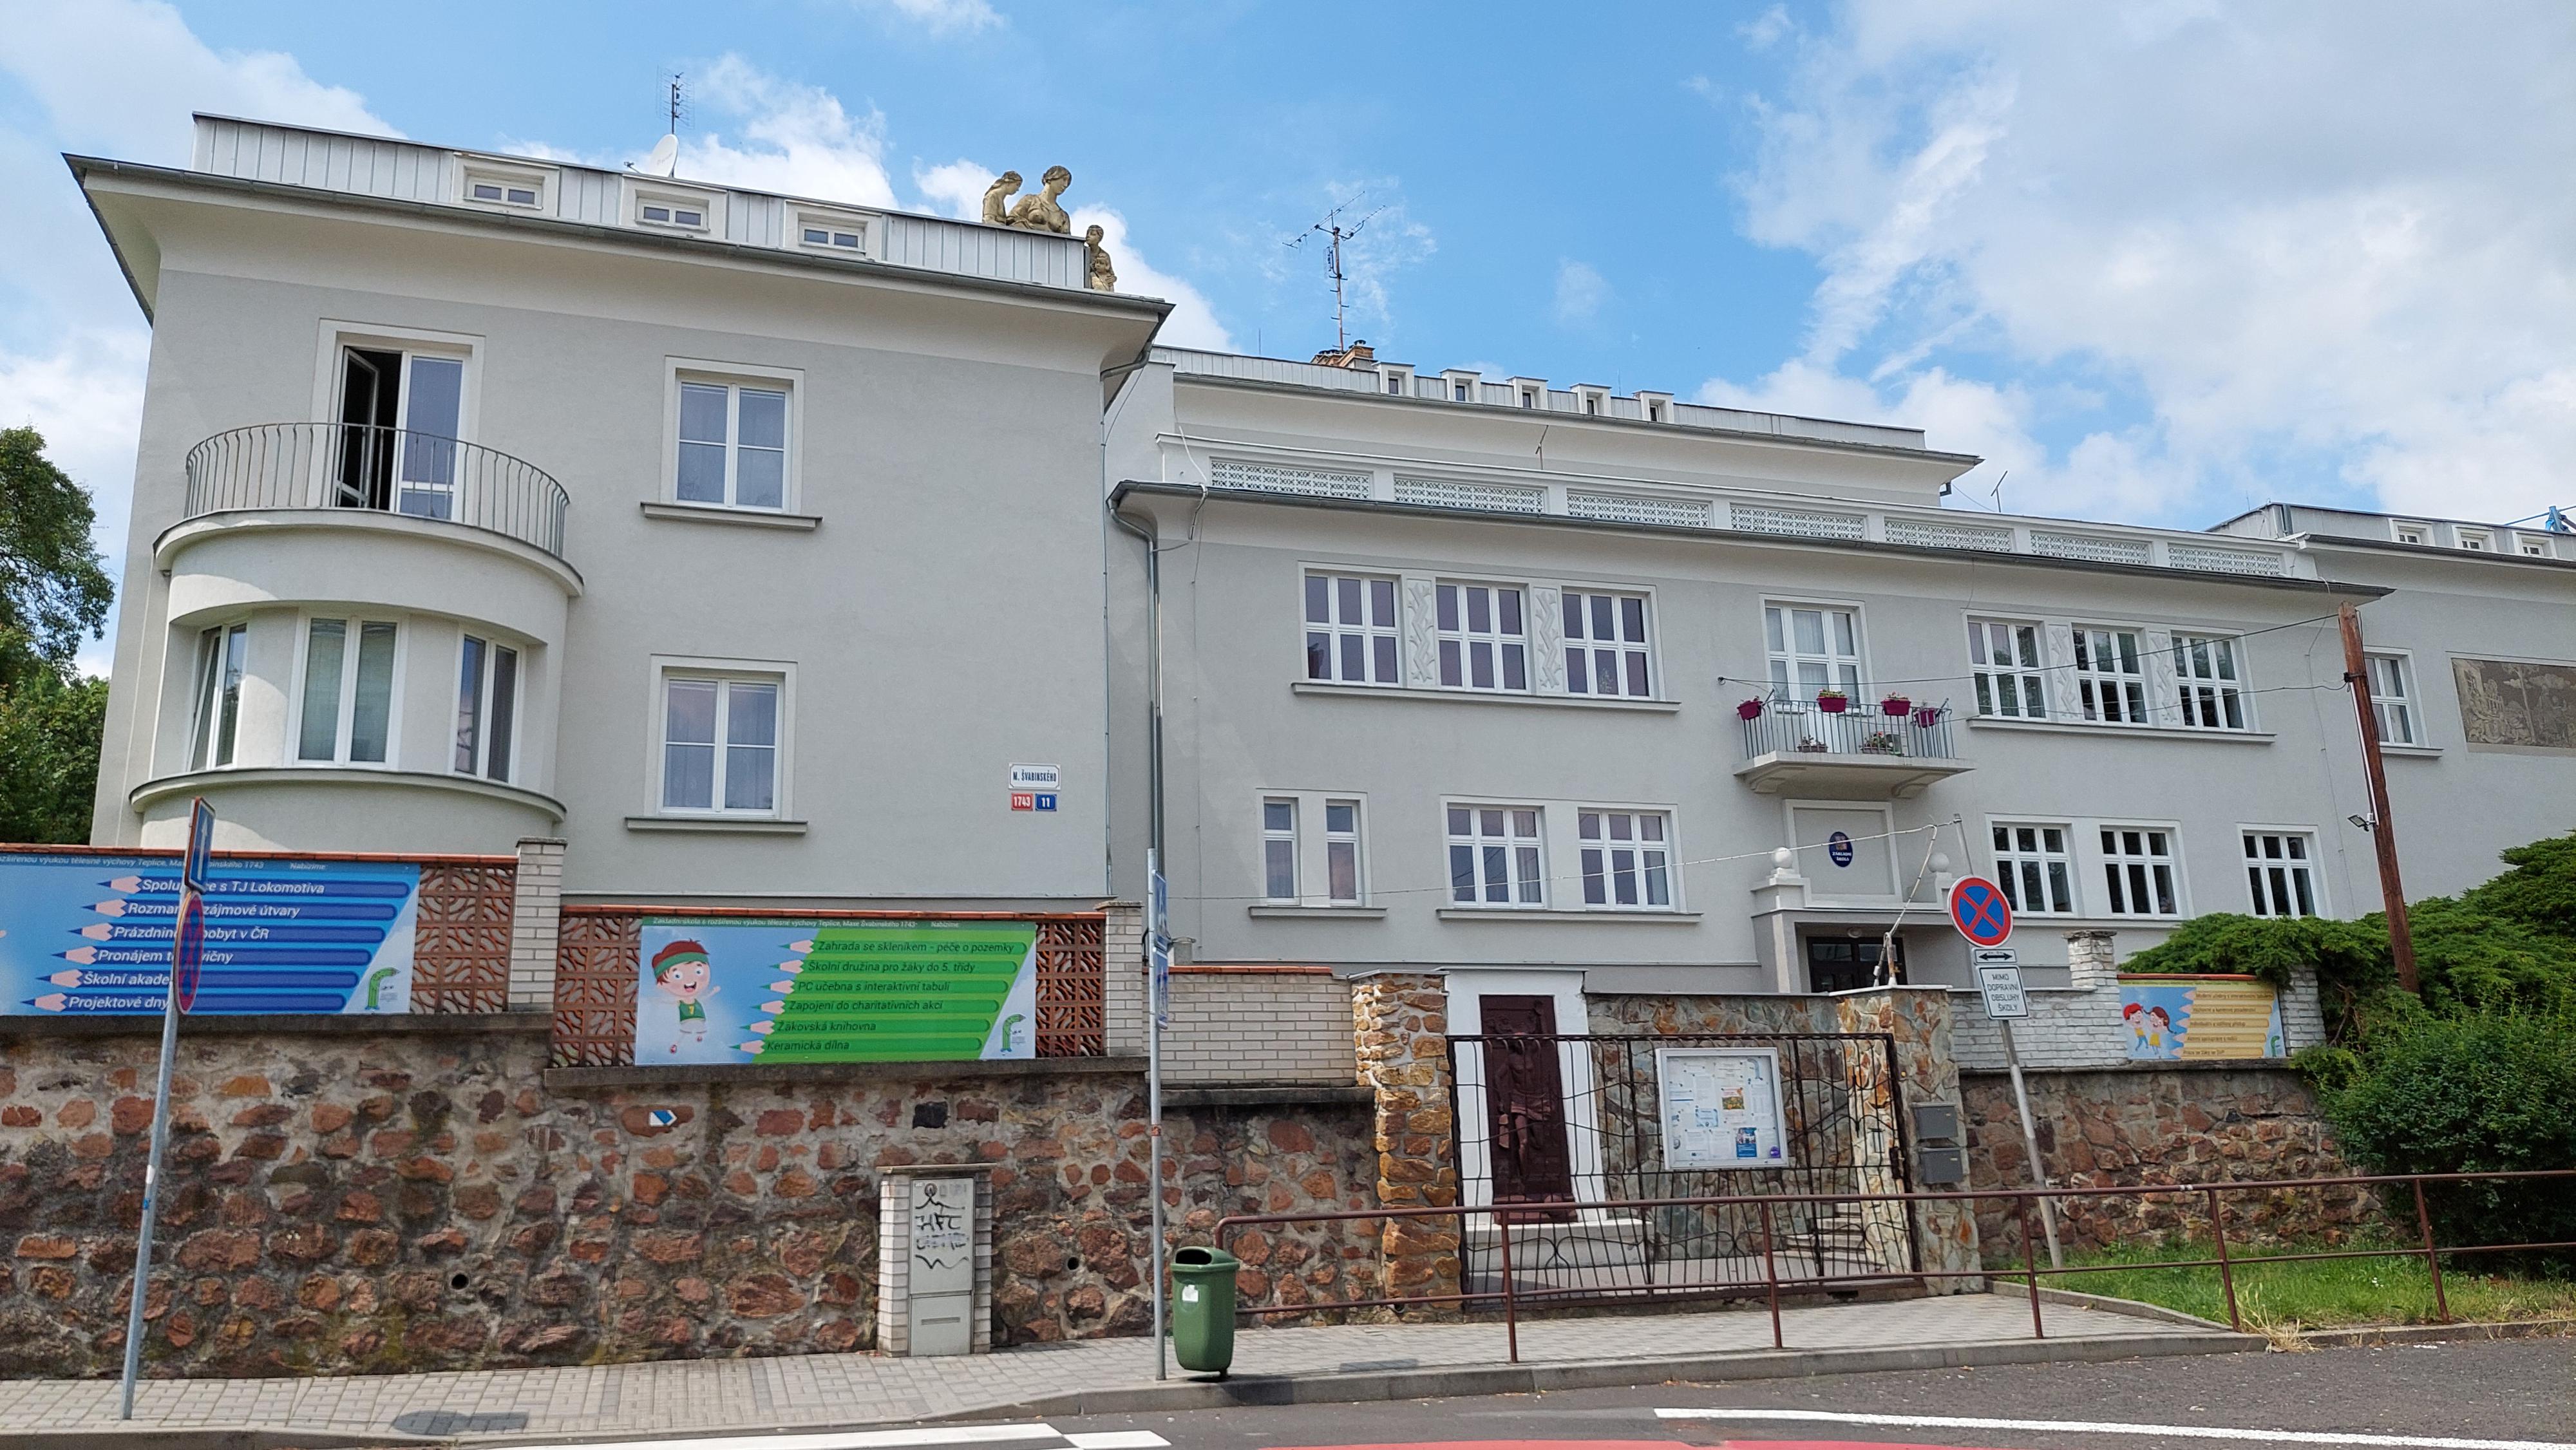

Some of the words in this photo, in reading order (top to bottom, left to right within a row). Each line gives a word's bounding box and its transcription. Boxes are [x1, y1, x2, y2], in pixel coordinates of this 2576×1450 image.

[1013, 771, 1019, 780] M.
[1021, 769, 1057, 782] ŠVABINSKÉHO
[1014, 796, 1030, 807] 1743
[1041, 797, 1050, 807] 11
[220, 883, 227, 891] s
[232, 881, 247, 892] TJ
[251, 881, 325, 894] Lokomotiva
[204, 904, 256, 916] zájmové
[259, 905, 300, 918] útvary
[240, 930, 247, 939] v
[251, 926, 269, 939] ČR
[819, 941, 860, 952] Zahrada
[863, 943, 875, 952] se
[878, 942, 927, 952] skleníkem
[971, 943, 1015, 954] pozemky
[98, 950, 162, 964] Pronájem
[808, 960, 840, 971] Školní
[843, 961, 880, 972] družina
[882, 964, 899, 973] pro
[902, 962, 923, 974] žáky
[927, 963, 939, 972] do
[942, 963, 951, 972] 5.
[954, 962, 975, 974] třídy
[83, 970, 128, 985] Školní
[799, 981, 813, 991] PC
[816, 981, 853, 991] učebna
[865, 981, 920, 992] interaktivní
[1987, 982, 2019, 991] DOPRAVNÍ
[68, 996, 142, 1010] Projektové
[145, 997, 169, 1010] dny
[790, 1001, 834, 1012] Zapojení
[837, 1001, 849, 1010] do
[852, 1000, 920, 1010] charitativních
[777, 1020, 827, 1031] Žákovská
[830, 1021, 876, 1031] knihovna
[767, 1040, 822, 1051] Keramická
[824, 1040, 849, 1050] dílna
